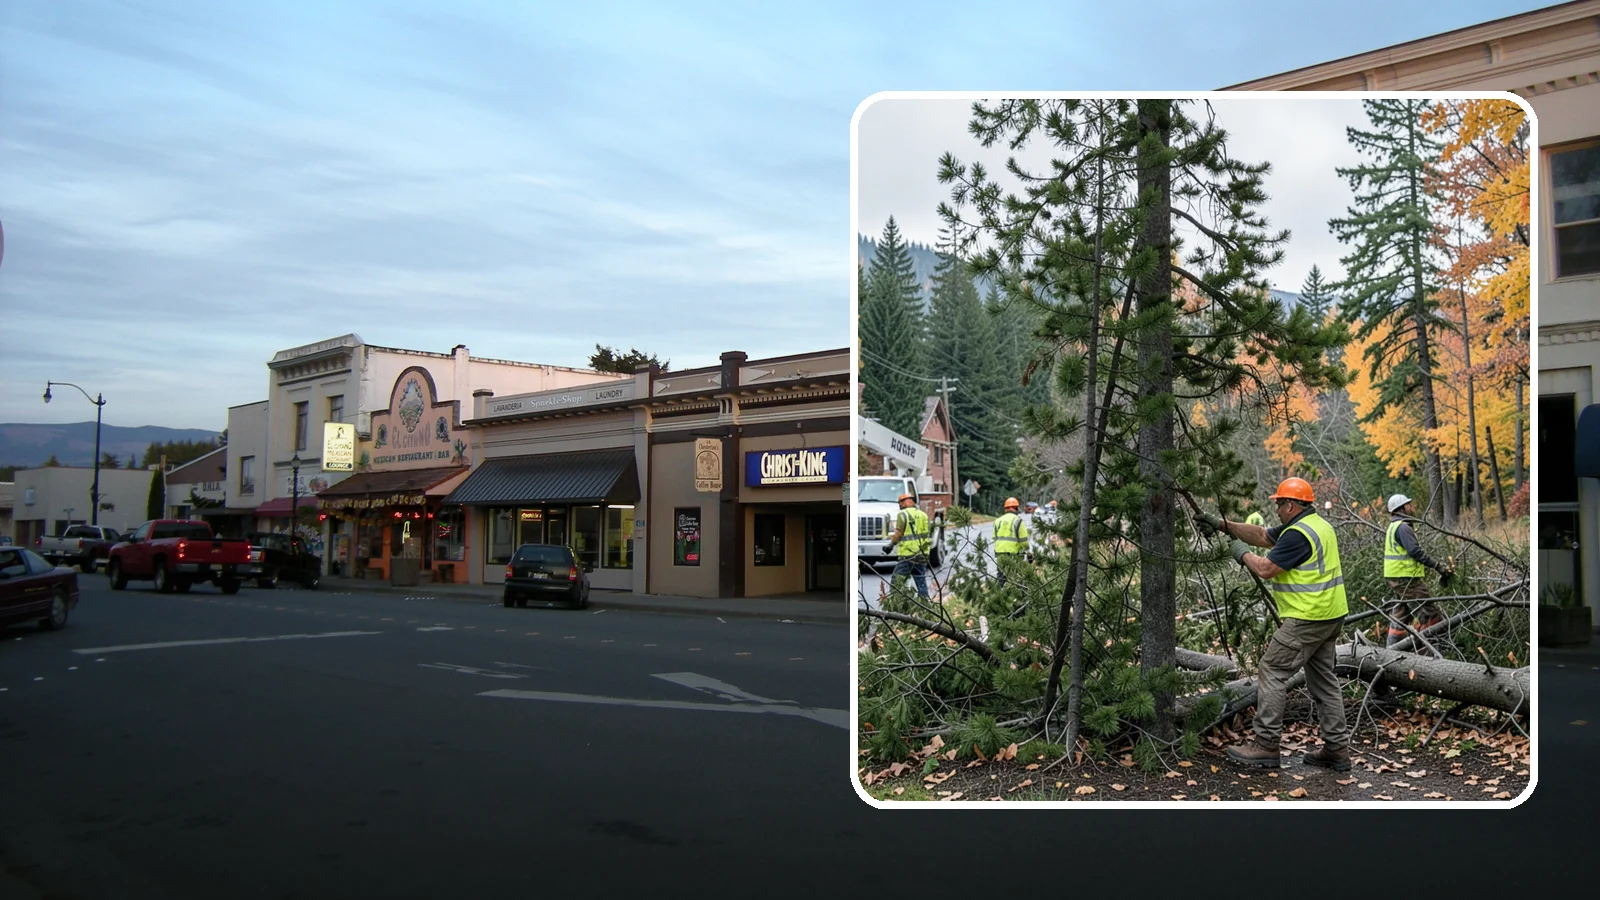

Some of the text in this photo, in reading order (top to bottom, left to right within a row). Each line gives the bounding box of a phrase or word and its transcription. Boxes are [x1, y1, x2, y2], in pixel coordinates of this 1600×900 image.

[493, 402, 522, 412] LAVANDERIA
[561, 394, 582, 406] Shop
[595, 389, 623, 400] LAUNDRY
[373, 454, 396, 464] MEXICAN
[397, 451, 434, 462] RESTAURANT
[438, 450, 450, 459] BAR
[760, 449, 827, 478] CHRIST KING
[696, 481, 709, 489] Coffee
